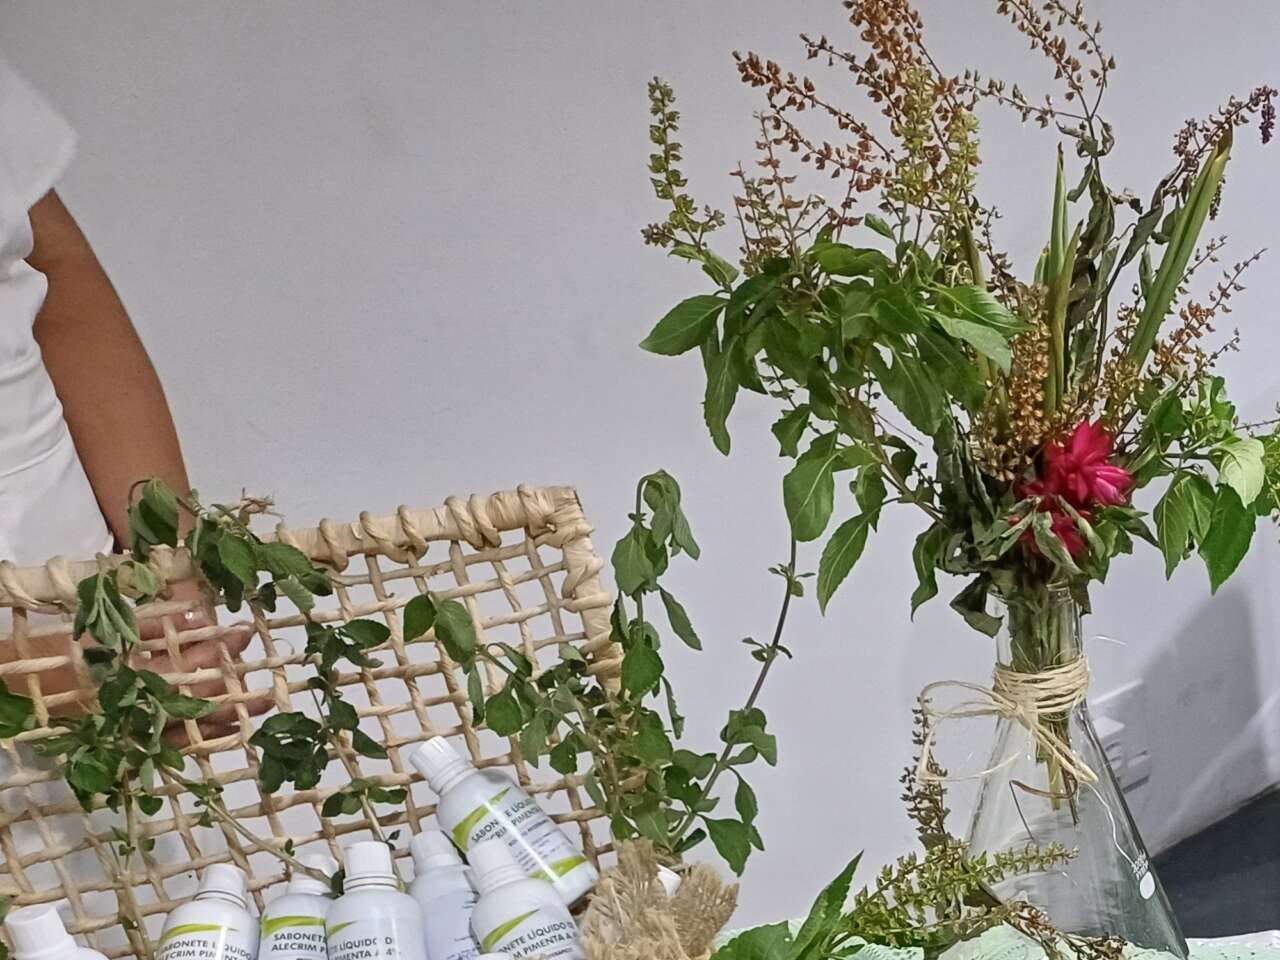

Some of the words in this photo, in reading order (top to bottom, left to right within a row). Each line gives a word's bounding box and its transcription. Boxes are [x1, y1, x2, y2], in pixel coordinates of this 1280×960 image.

[527, 922, 567, 940] LÍQUIDO
[270, 942, 318, 952] ALECRIM
[523, 934, 565, 955] PIMENTA
